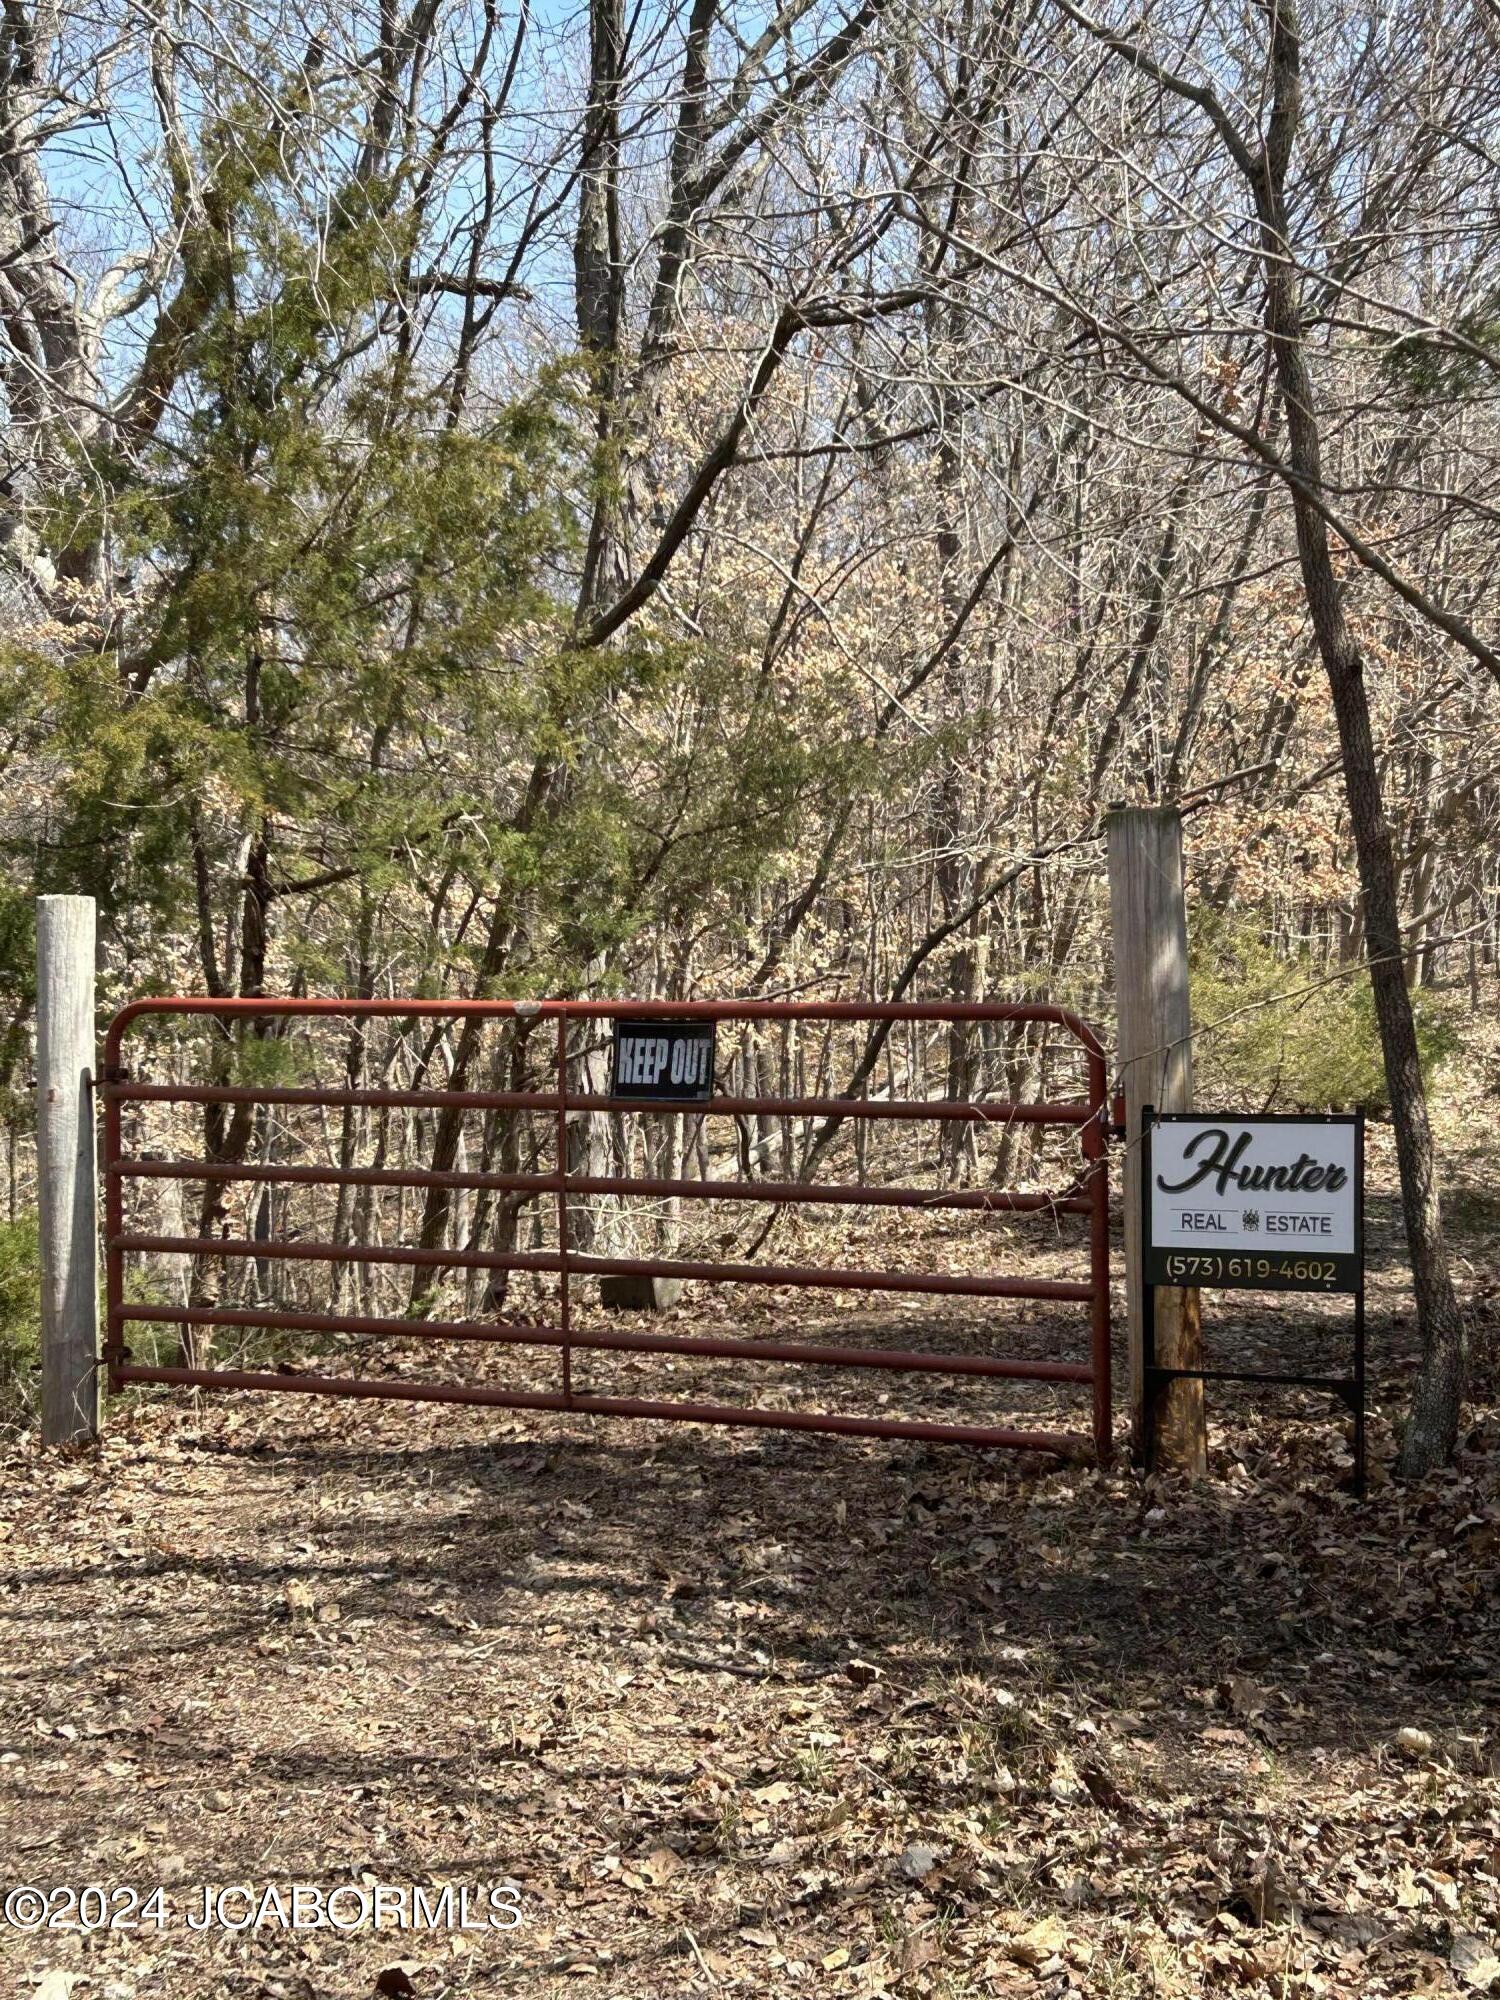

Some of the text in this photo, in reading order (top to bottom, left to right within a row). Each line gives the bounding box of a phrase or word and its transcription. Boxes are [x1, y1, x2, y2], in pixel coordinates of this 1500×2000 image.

[618, 1037, 712, 1085] KEEP OUT
[1156, 1128, 1349, 1197] Hunter
[1181, 1212, 1332, 1233] REAL ESTATE
